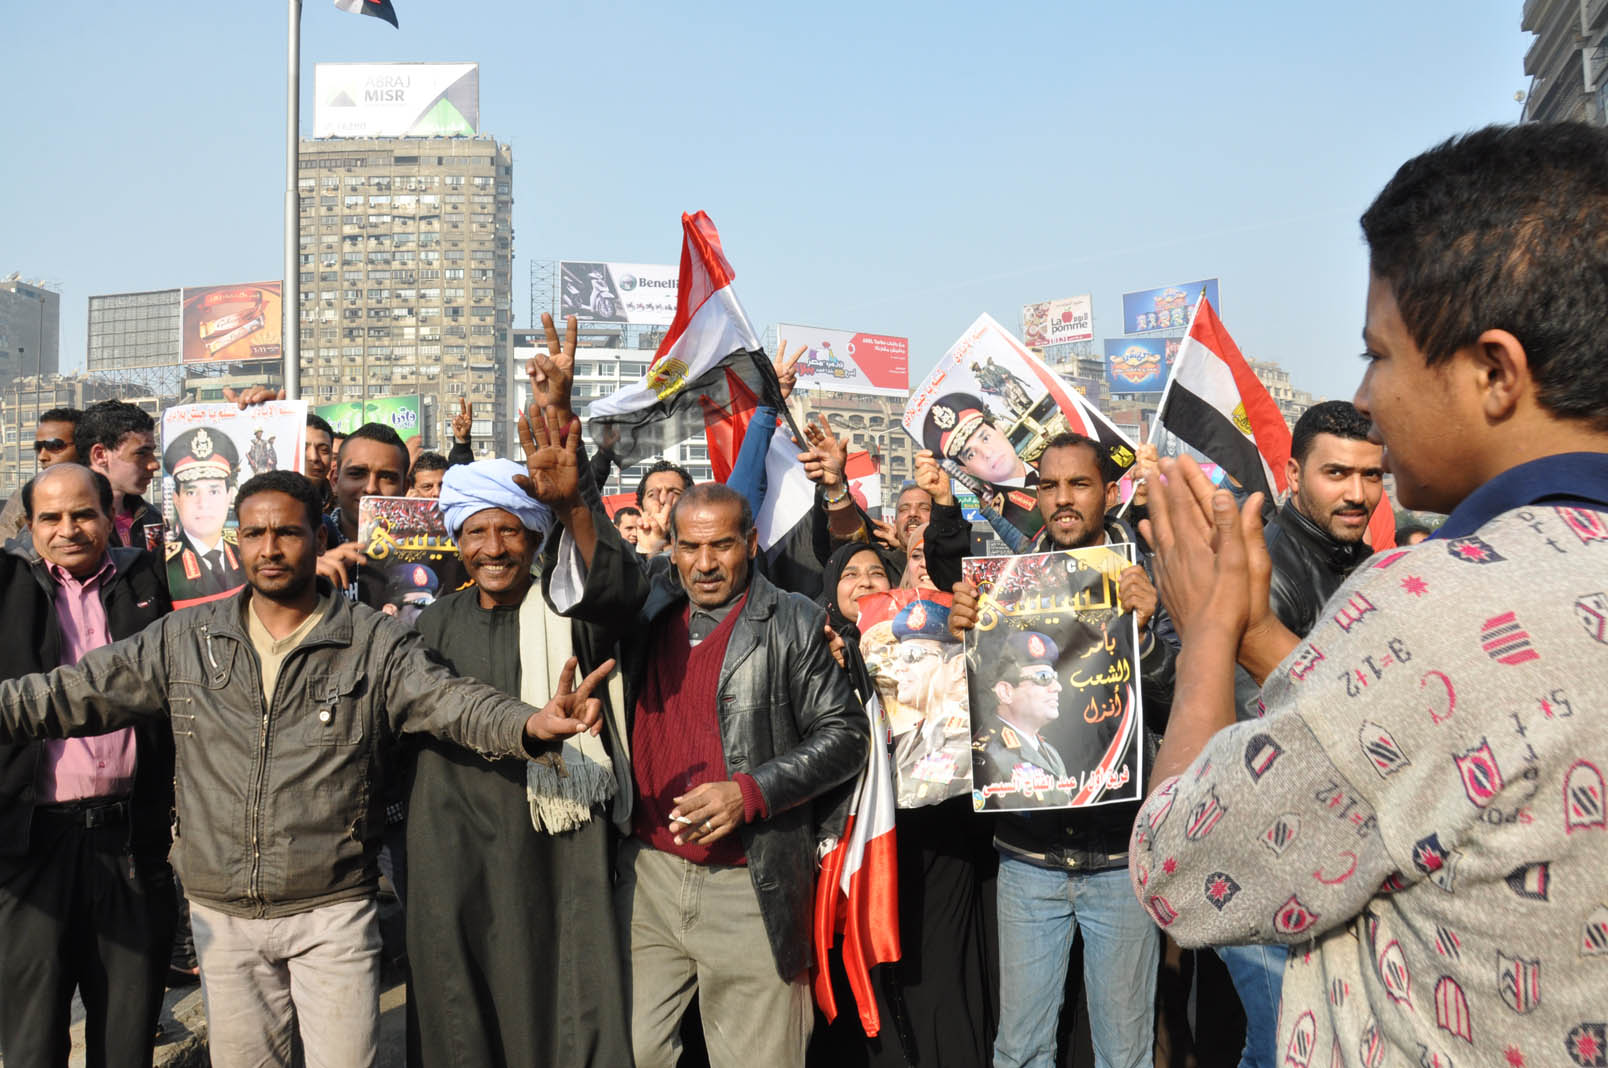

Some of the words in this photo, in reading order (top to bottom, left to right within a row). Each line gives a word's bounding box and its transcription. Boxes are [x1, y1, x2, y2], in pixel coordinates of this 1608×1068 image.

[364, 89, 405, 102] MISR
[639, 277, 679, 289] Benelli
[1051, 317, 1062, 326] La
[1051, 320, 1088, 335] pomme
[1070, 657, 1131, 693] الشعب
[1022, 768, 1055, 798] الفتاح
[1056, 776, 1077, 793] عبد
[1106, 764, 1130, 790] فريق
